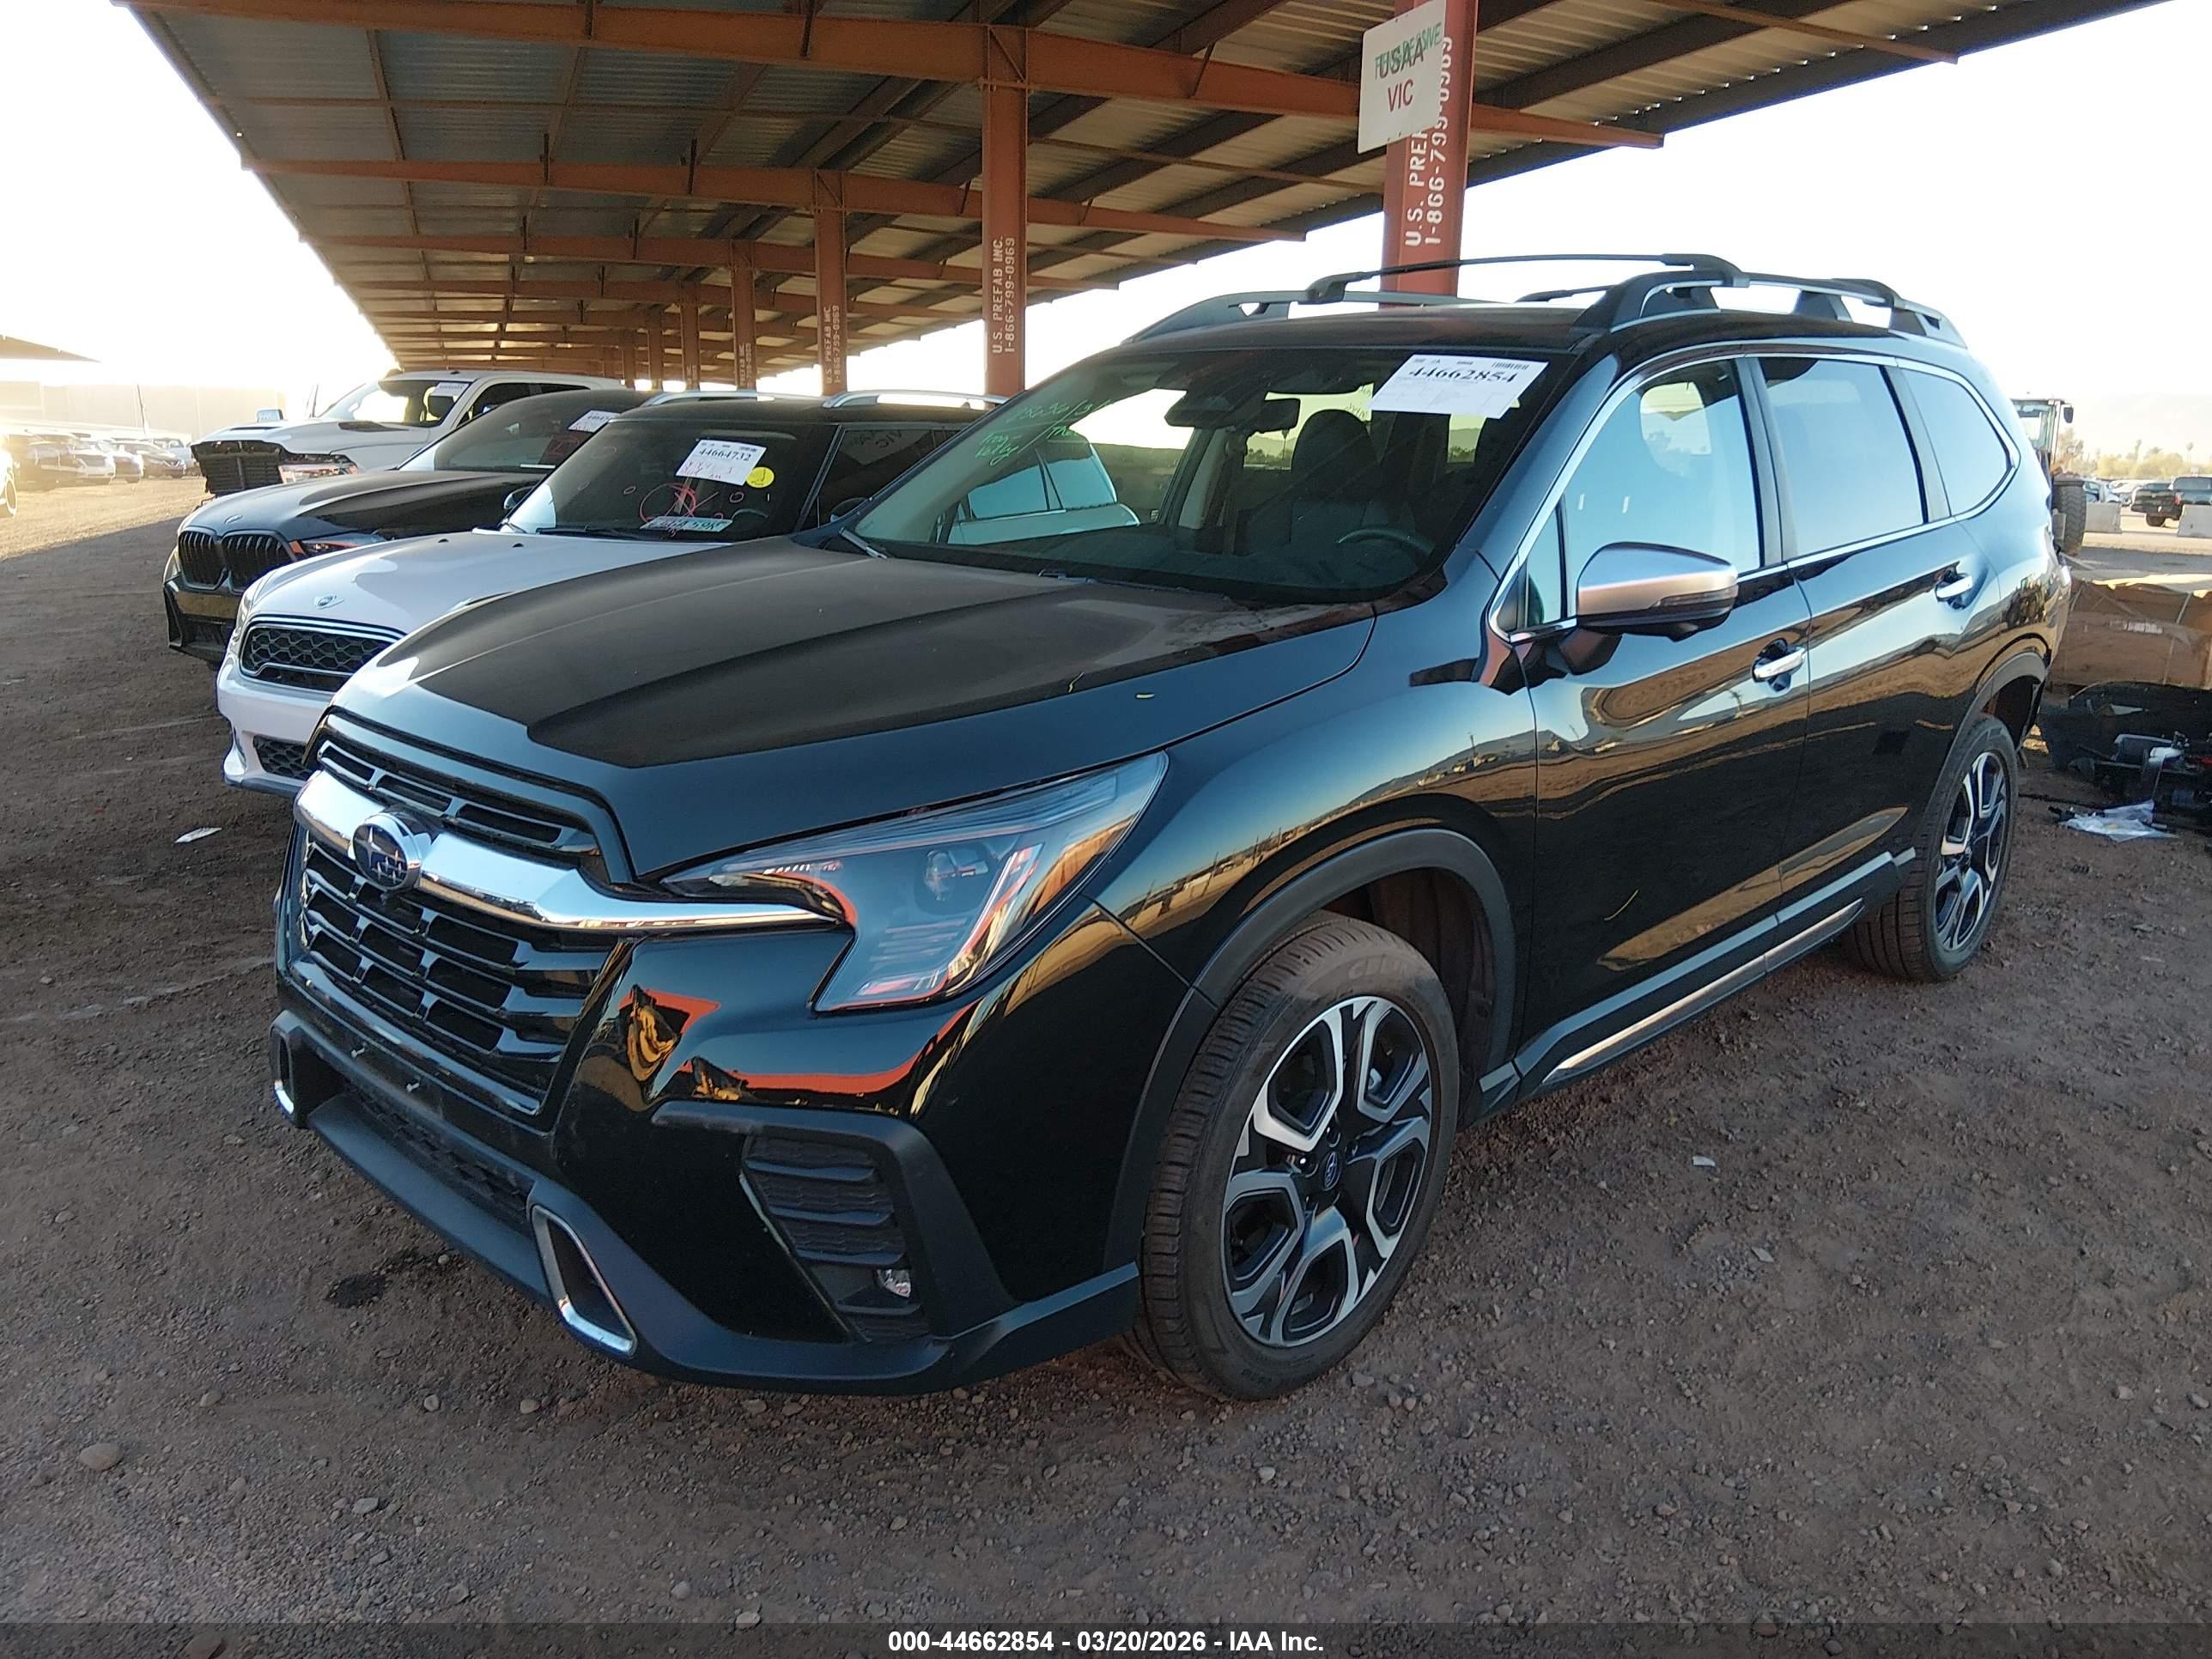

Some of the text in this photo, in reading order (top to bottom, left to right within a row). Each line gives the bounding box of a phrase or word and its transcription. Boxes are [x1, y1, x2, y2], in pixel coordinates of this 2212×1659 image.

[1379, 36, 1424, 79] USAA
[1388, 78, 1414, 112] VIC
[1405, 200, 1425, 247] U.S.
[993, 236, 1004, 354] U.S. PREFAB INC.
[1005, 237, 1015, 353] 1-866-799-0969
[1408, 365, 1518, 383] 44662854
